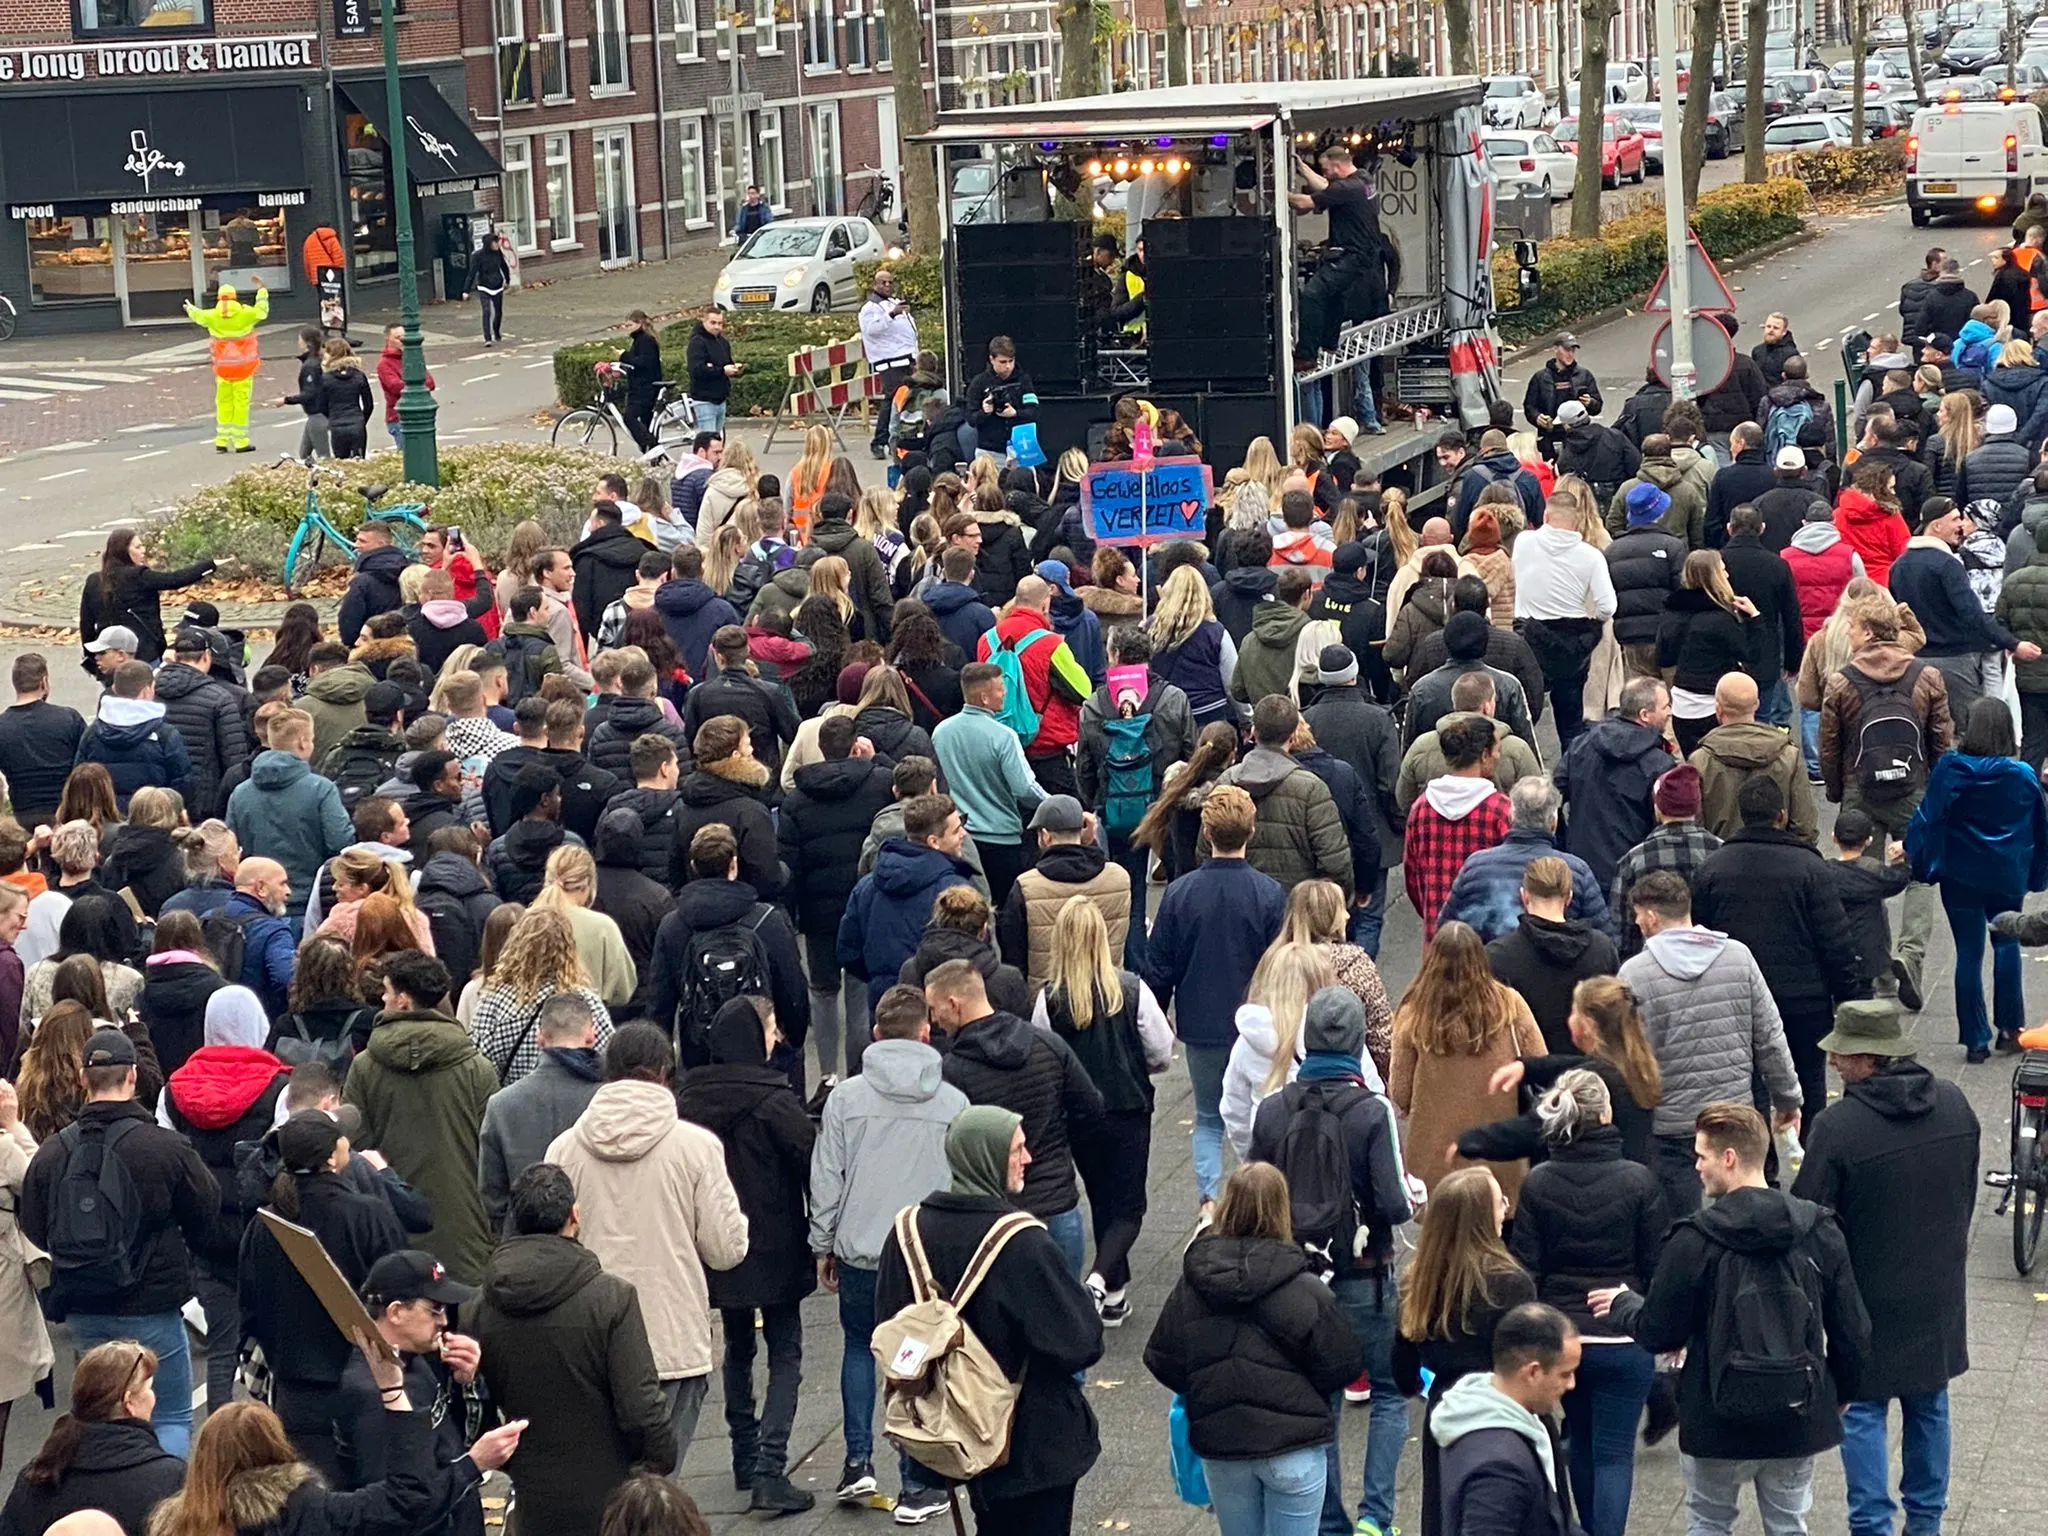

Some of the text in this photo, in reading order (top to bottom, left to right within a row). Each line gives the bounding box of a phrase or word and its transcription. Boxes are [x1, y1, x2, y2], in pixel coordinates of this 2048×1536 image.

[20, 50, 85, 80] Jong
[97, 45, 180, 75] brood
[186, 43, 209, 71] &
[215, 39, 312, 70] banket
[11, 191, 305, 219] brood sandwichbar banket
